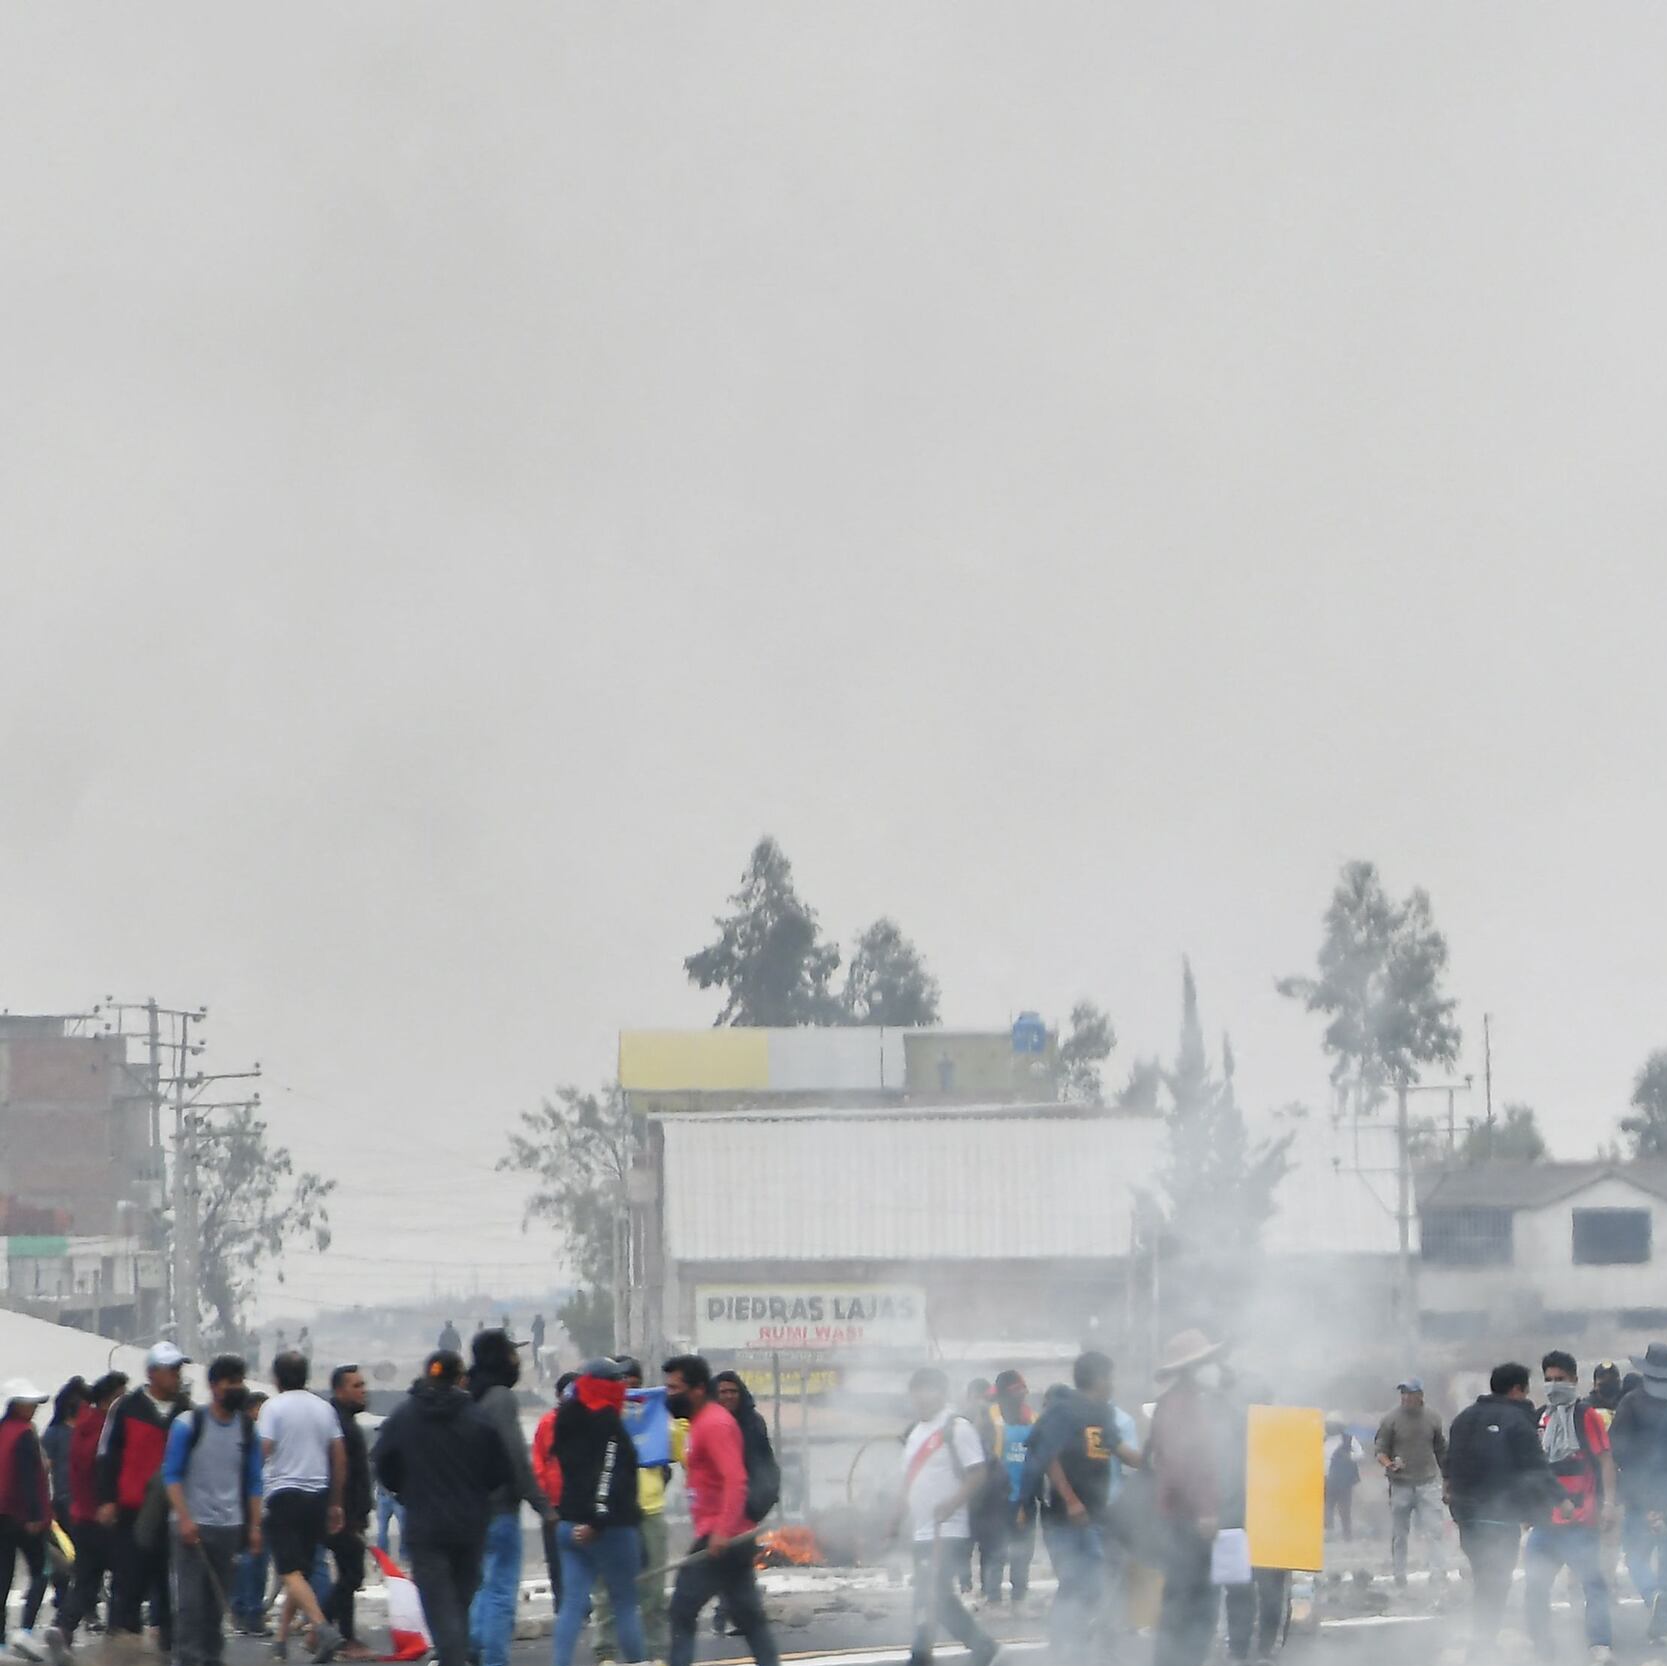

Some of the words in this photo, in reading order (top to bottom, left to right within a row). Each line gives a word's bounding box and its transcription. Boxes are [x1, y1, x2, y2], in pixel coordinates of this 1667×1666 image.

[707, 1296, 824, 1321] PIEDRAS
[833, 1296, 914, 1321] LAJAS
[758, 1325, 807, 1340] RUMI
